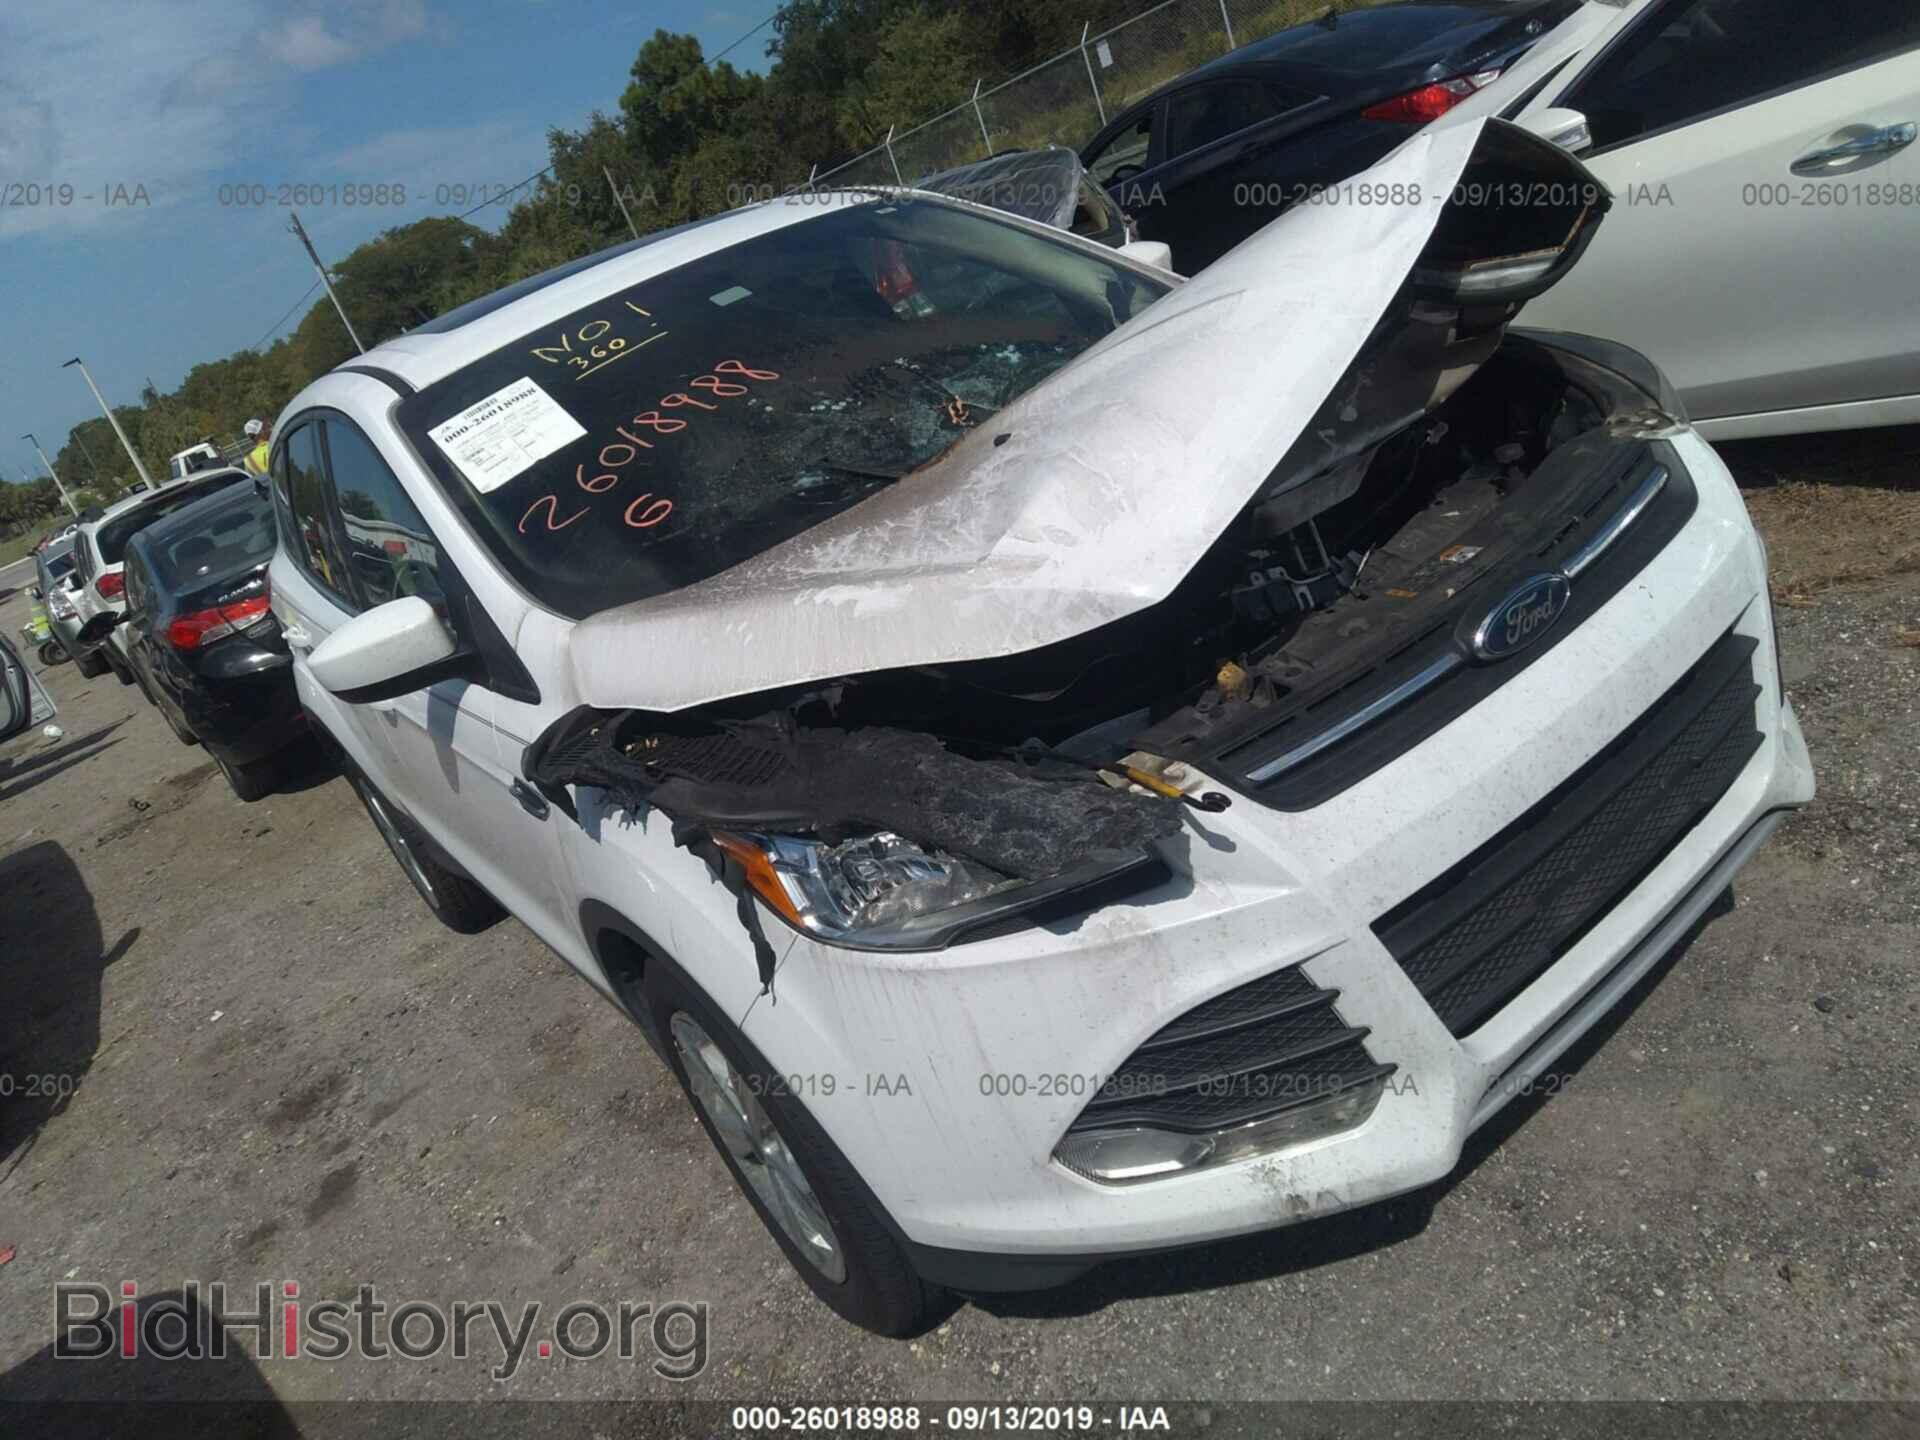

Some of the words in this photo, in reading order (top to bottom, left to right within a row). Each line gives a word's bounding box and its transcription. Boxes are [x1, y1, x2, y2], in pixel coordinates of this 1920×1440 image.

[567, 338, 626, 370] 360
[518, 360, 780, 534] 26018988
[1505, 588, 1554, 645] Ford
